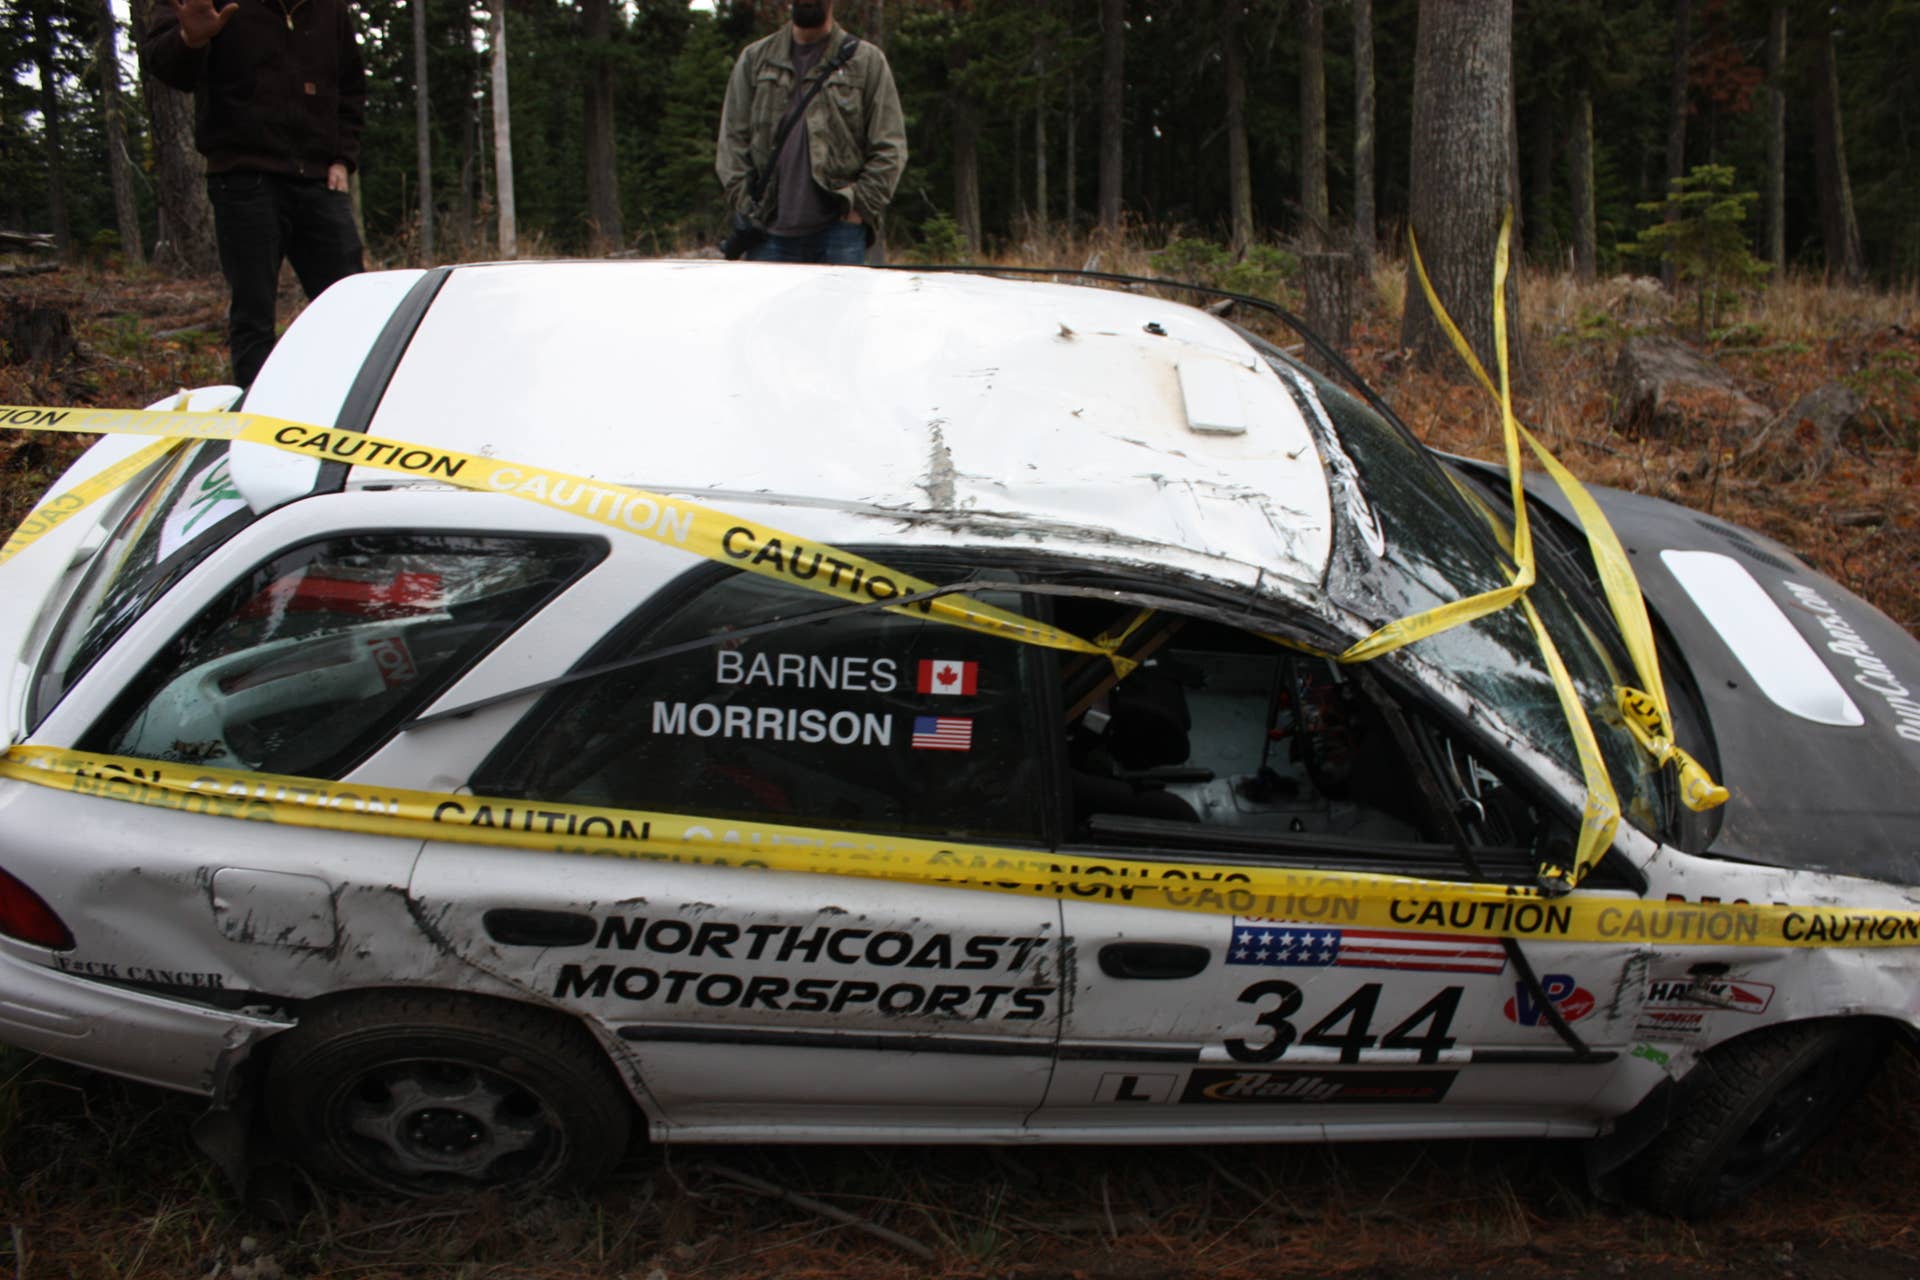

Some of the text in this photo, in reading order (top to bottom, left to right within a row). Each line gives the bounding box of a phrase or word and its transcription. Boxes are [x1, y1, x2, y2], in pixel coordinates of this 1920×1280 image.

[274, 426, 467, 478] CAUTION
[488, 467, 693, 544] CAUTION
[716, 651, 898, 693] BARNES
[652, 701, 892, 745] MORRISON
[596, 915, 1048, 971] NORTHCOAST
[1389, 899, 1572, 933] CAUTION
[1599, 907, 1758, 940] CAUTION
[1782, 913, 1920, 942] CAUTION
[127, 967, 224, 988] CANCER
[554, 964, 1054, 1020] MOTORSPORTS
[1224, 979, 1464, 1064] 344
